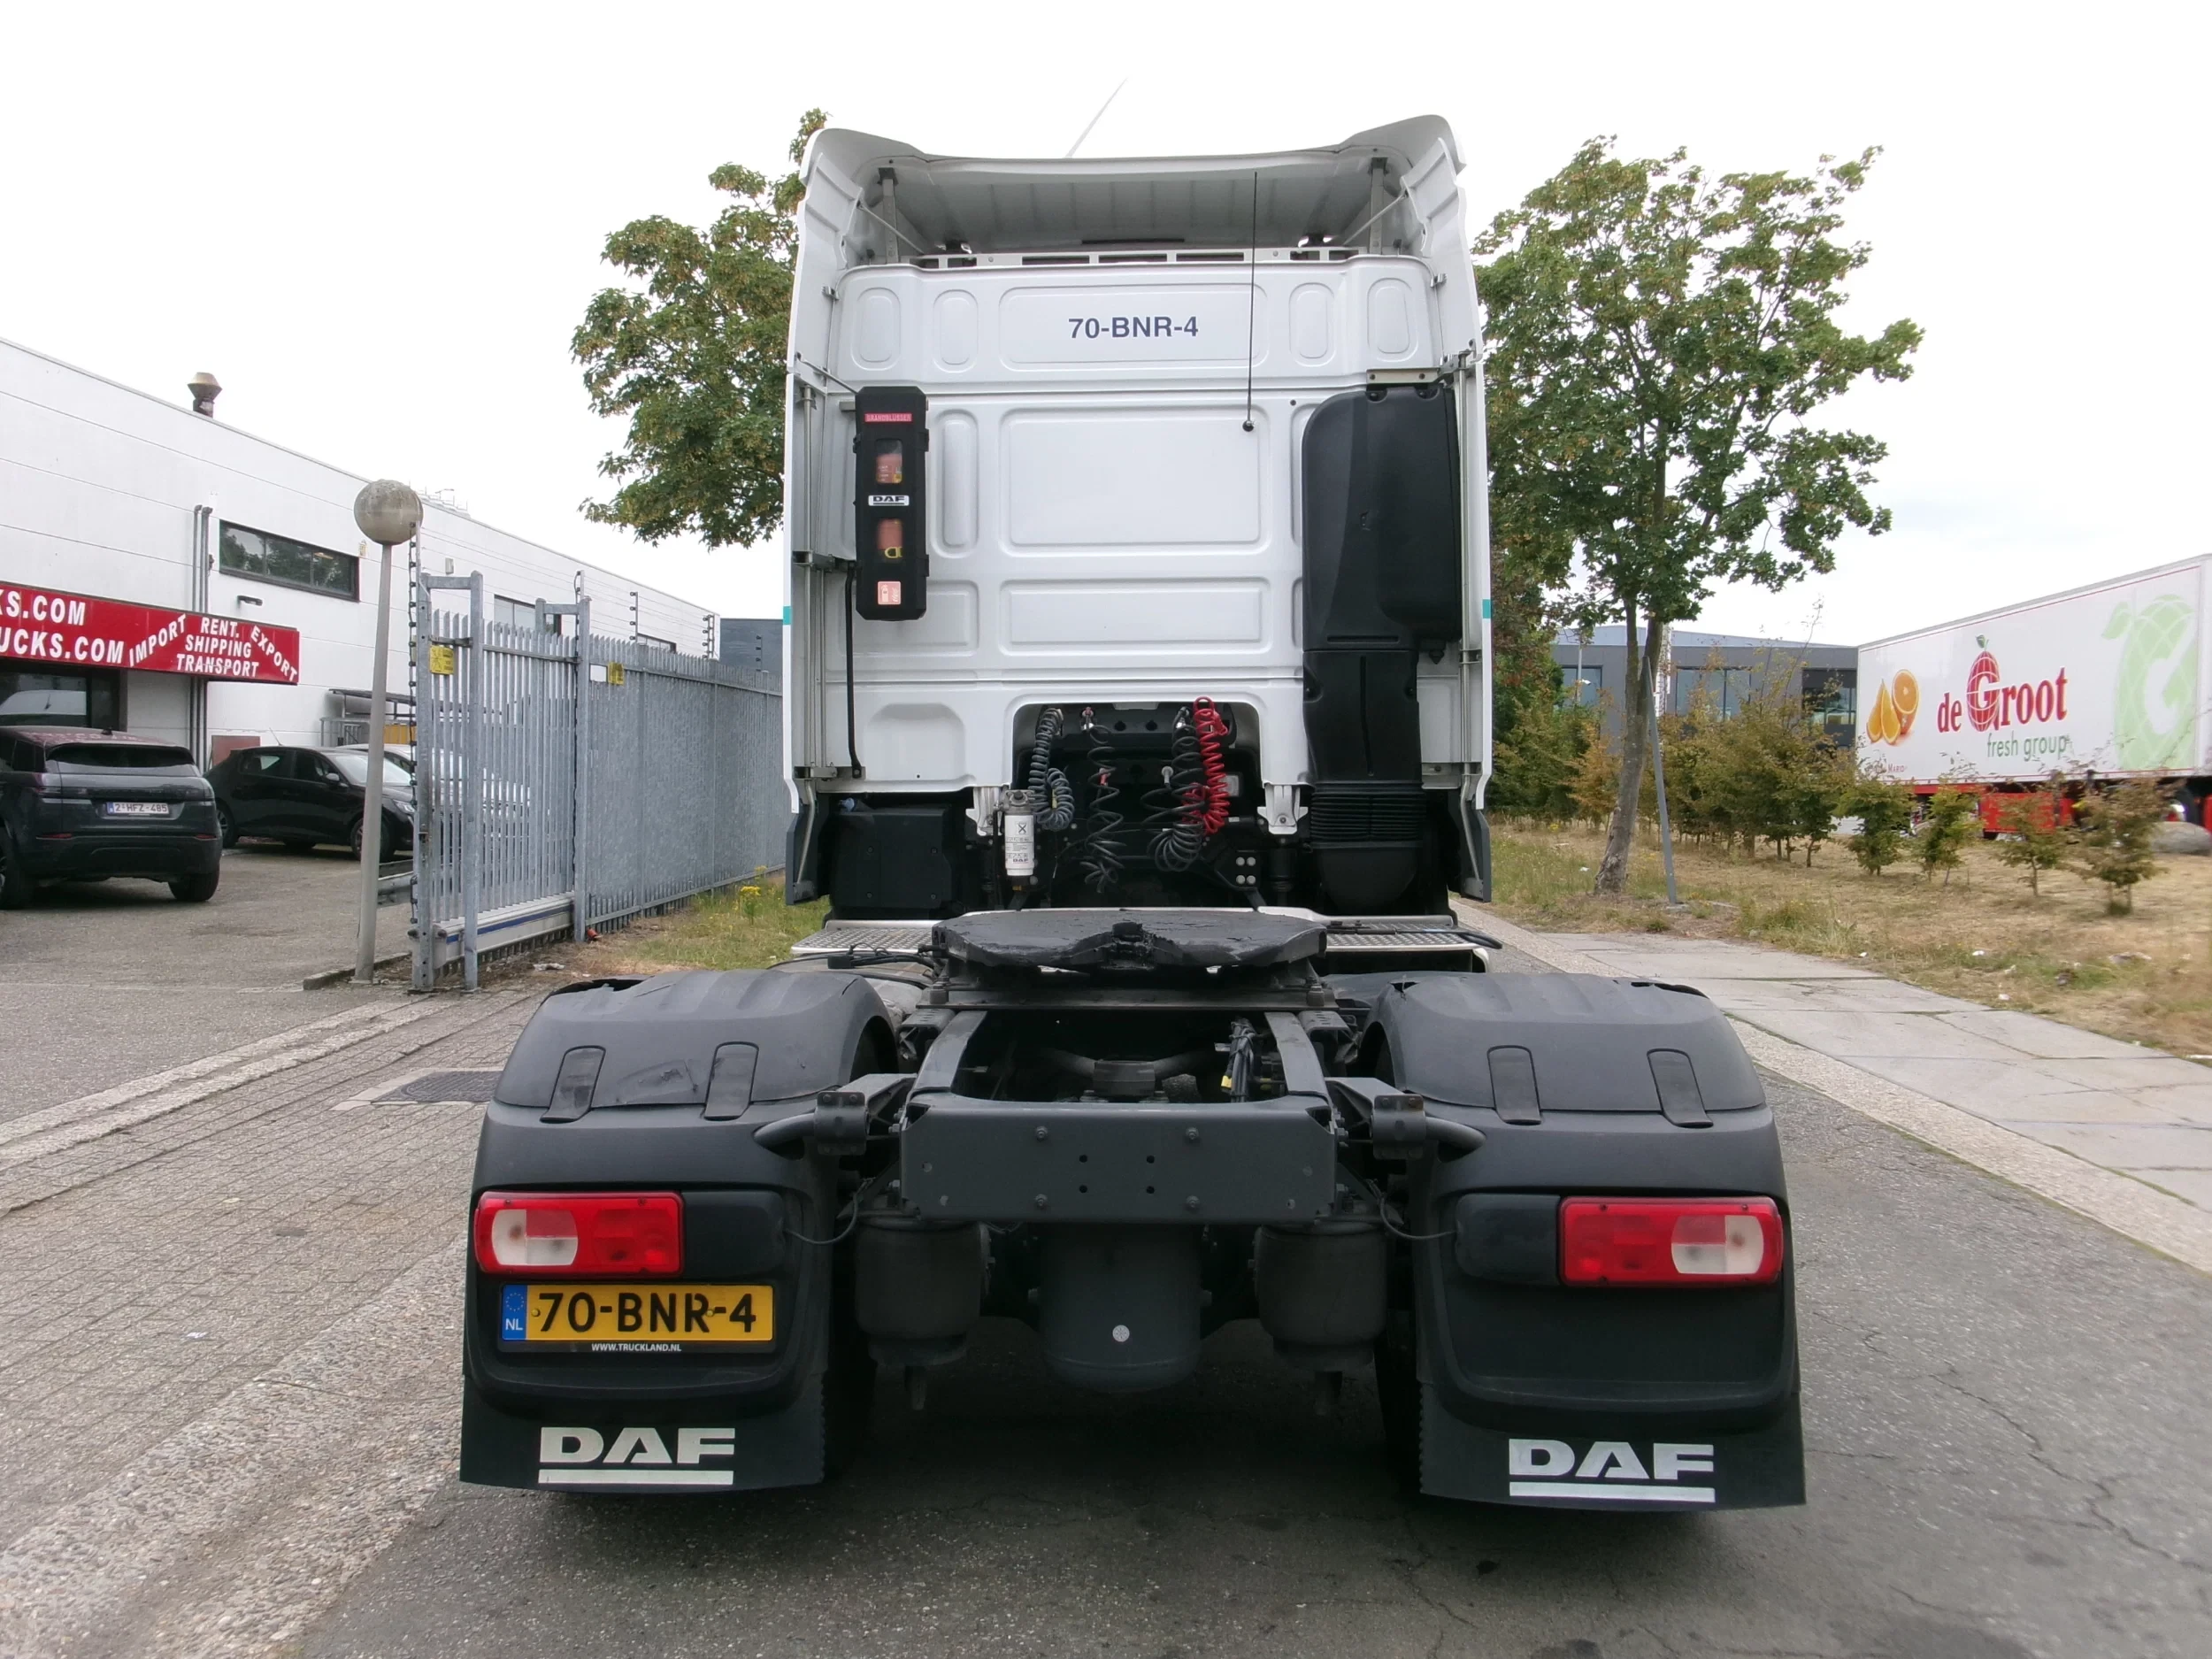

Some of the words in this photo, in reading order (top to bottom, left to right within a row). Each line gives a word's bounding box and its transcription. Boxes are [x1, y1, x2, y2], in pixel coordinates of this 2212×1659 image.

[1068, 316, 1199, 339] 70-BNR-4
[0, 588, 86, 626] S.COM
[129, 613, 187, 667] IMPORT
[185, 634, 252, 658] SHIPPING
[200, 617, 240, 638] RENT.
[176, 653, 259, 678] TRANSPORT
[250, 625, 298, 682] EXPORT
[1937, 692, 1962, 733] de
[1966, 650, 2068, 732] Groot
[1987, 731, 2018, 757] fresh
[2024, 734, 2068, 762] group
[505, 1319, 523, 1331] NL
[539, 1293, 757, 1333] 70-BNR-4
[591, 1342, 682, 1353] WWW.TRUCKLAND.NL
[539, 1426, 735, 1465] DAF
[1509, 1438, 1715, 1481] DAF
